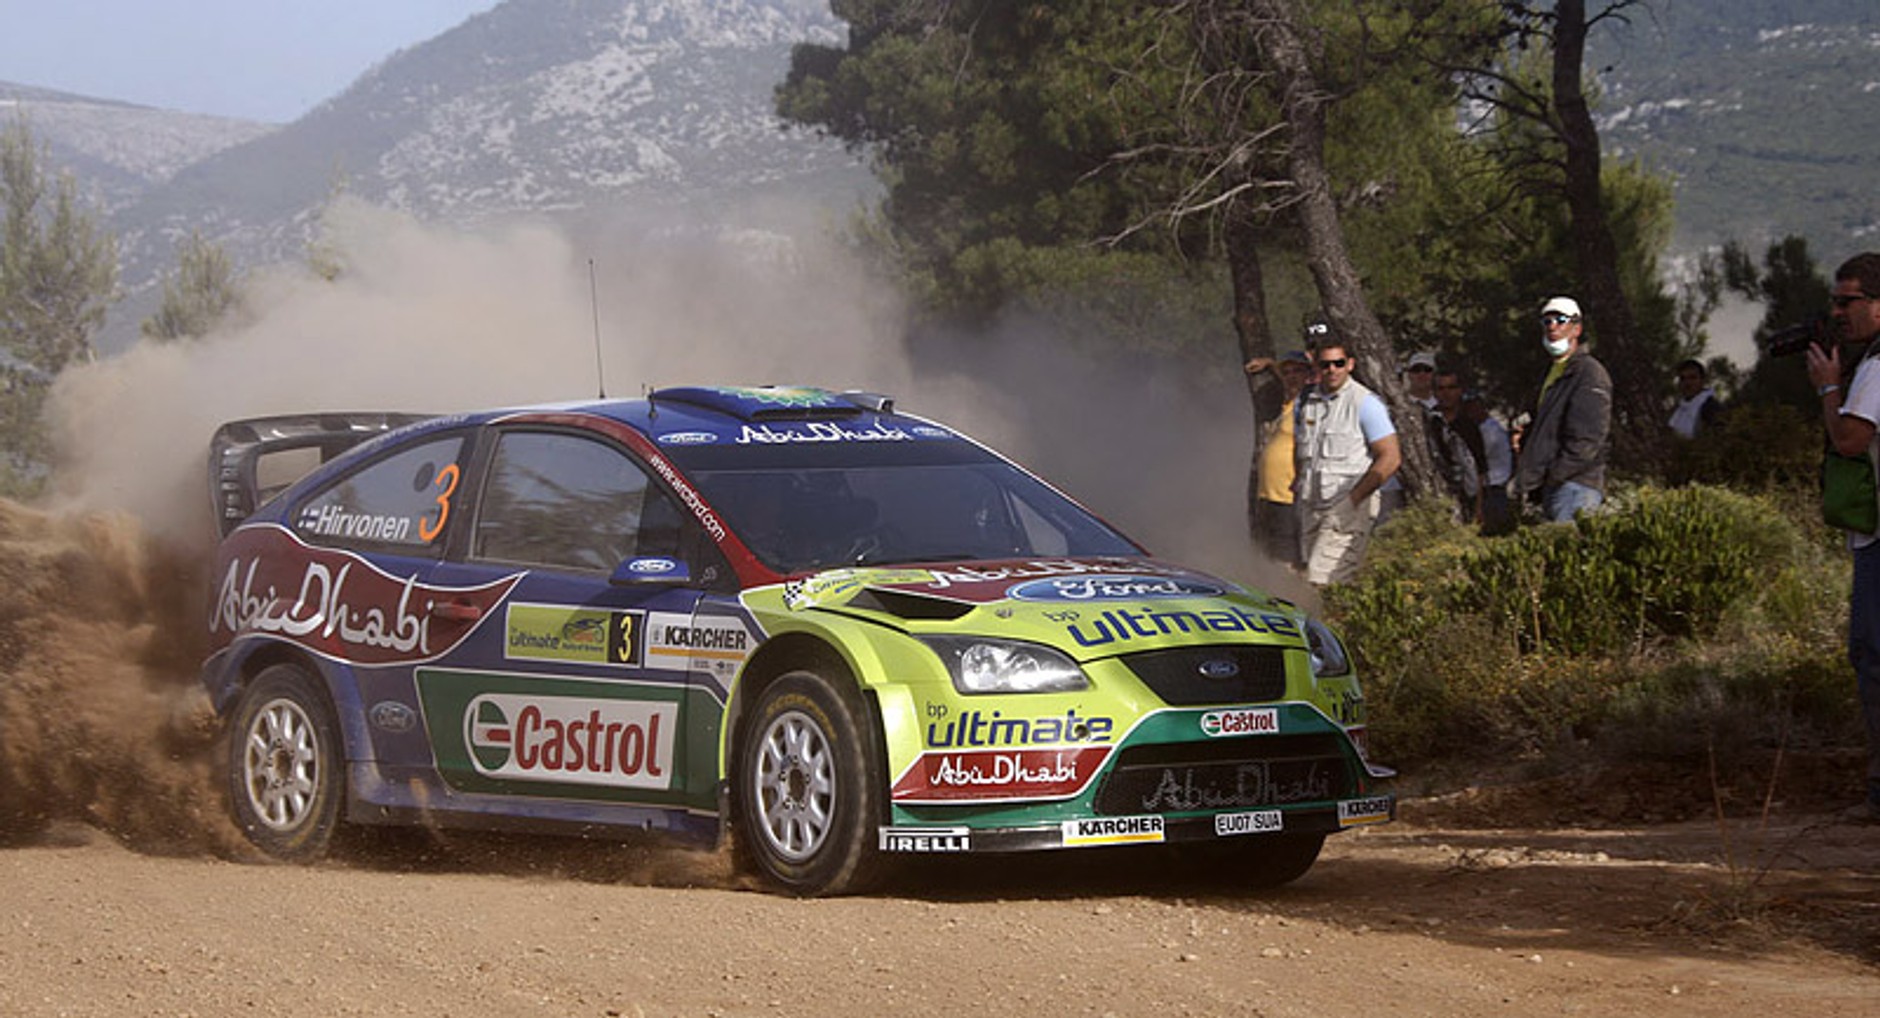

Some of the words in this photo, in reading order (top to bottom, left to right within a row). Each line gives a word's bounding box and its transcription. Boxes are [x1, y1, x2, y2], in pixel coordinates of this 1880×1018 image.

[417, 463, 460, 541] 3
[314, 504, 410, 540] Hirvonen
[1052, 577, 1191, 600] Ford
[617, 615, 632, 662] 3
[664, 626, 747, 650] KÄRCHER
[1066, 606, 1301, 648] ultimate
[926, 702, 948, 719] bp
[928, 708, 1114, 748] ultimate
[1220, 712, 1277, 733] Castrol
[514, 704, 662, 777] Castrol
[879, 826, 971, 851] PIRELLI
